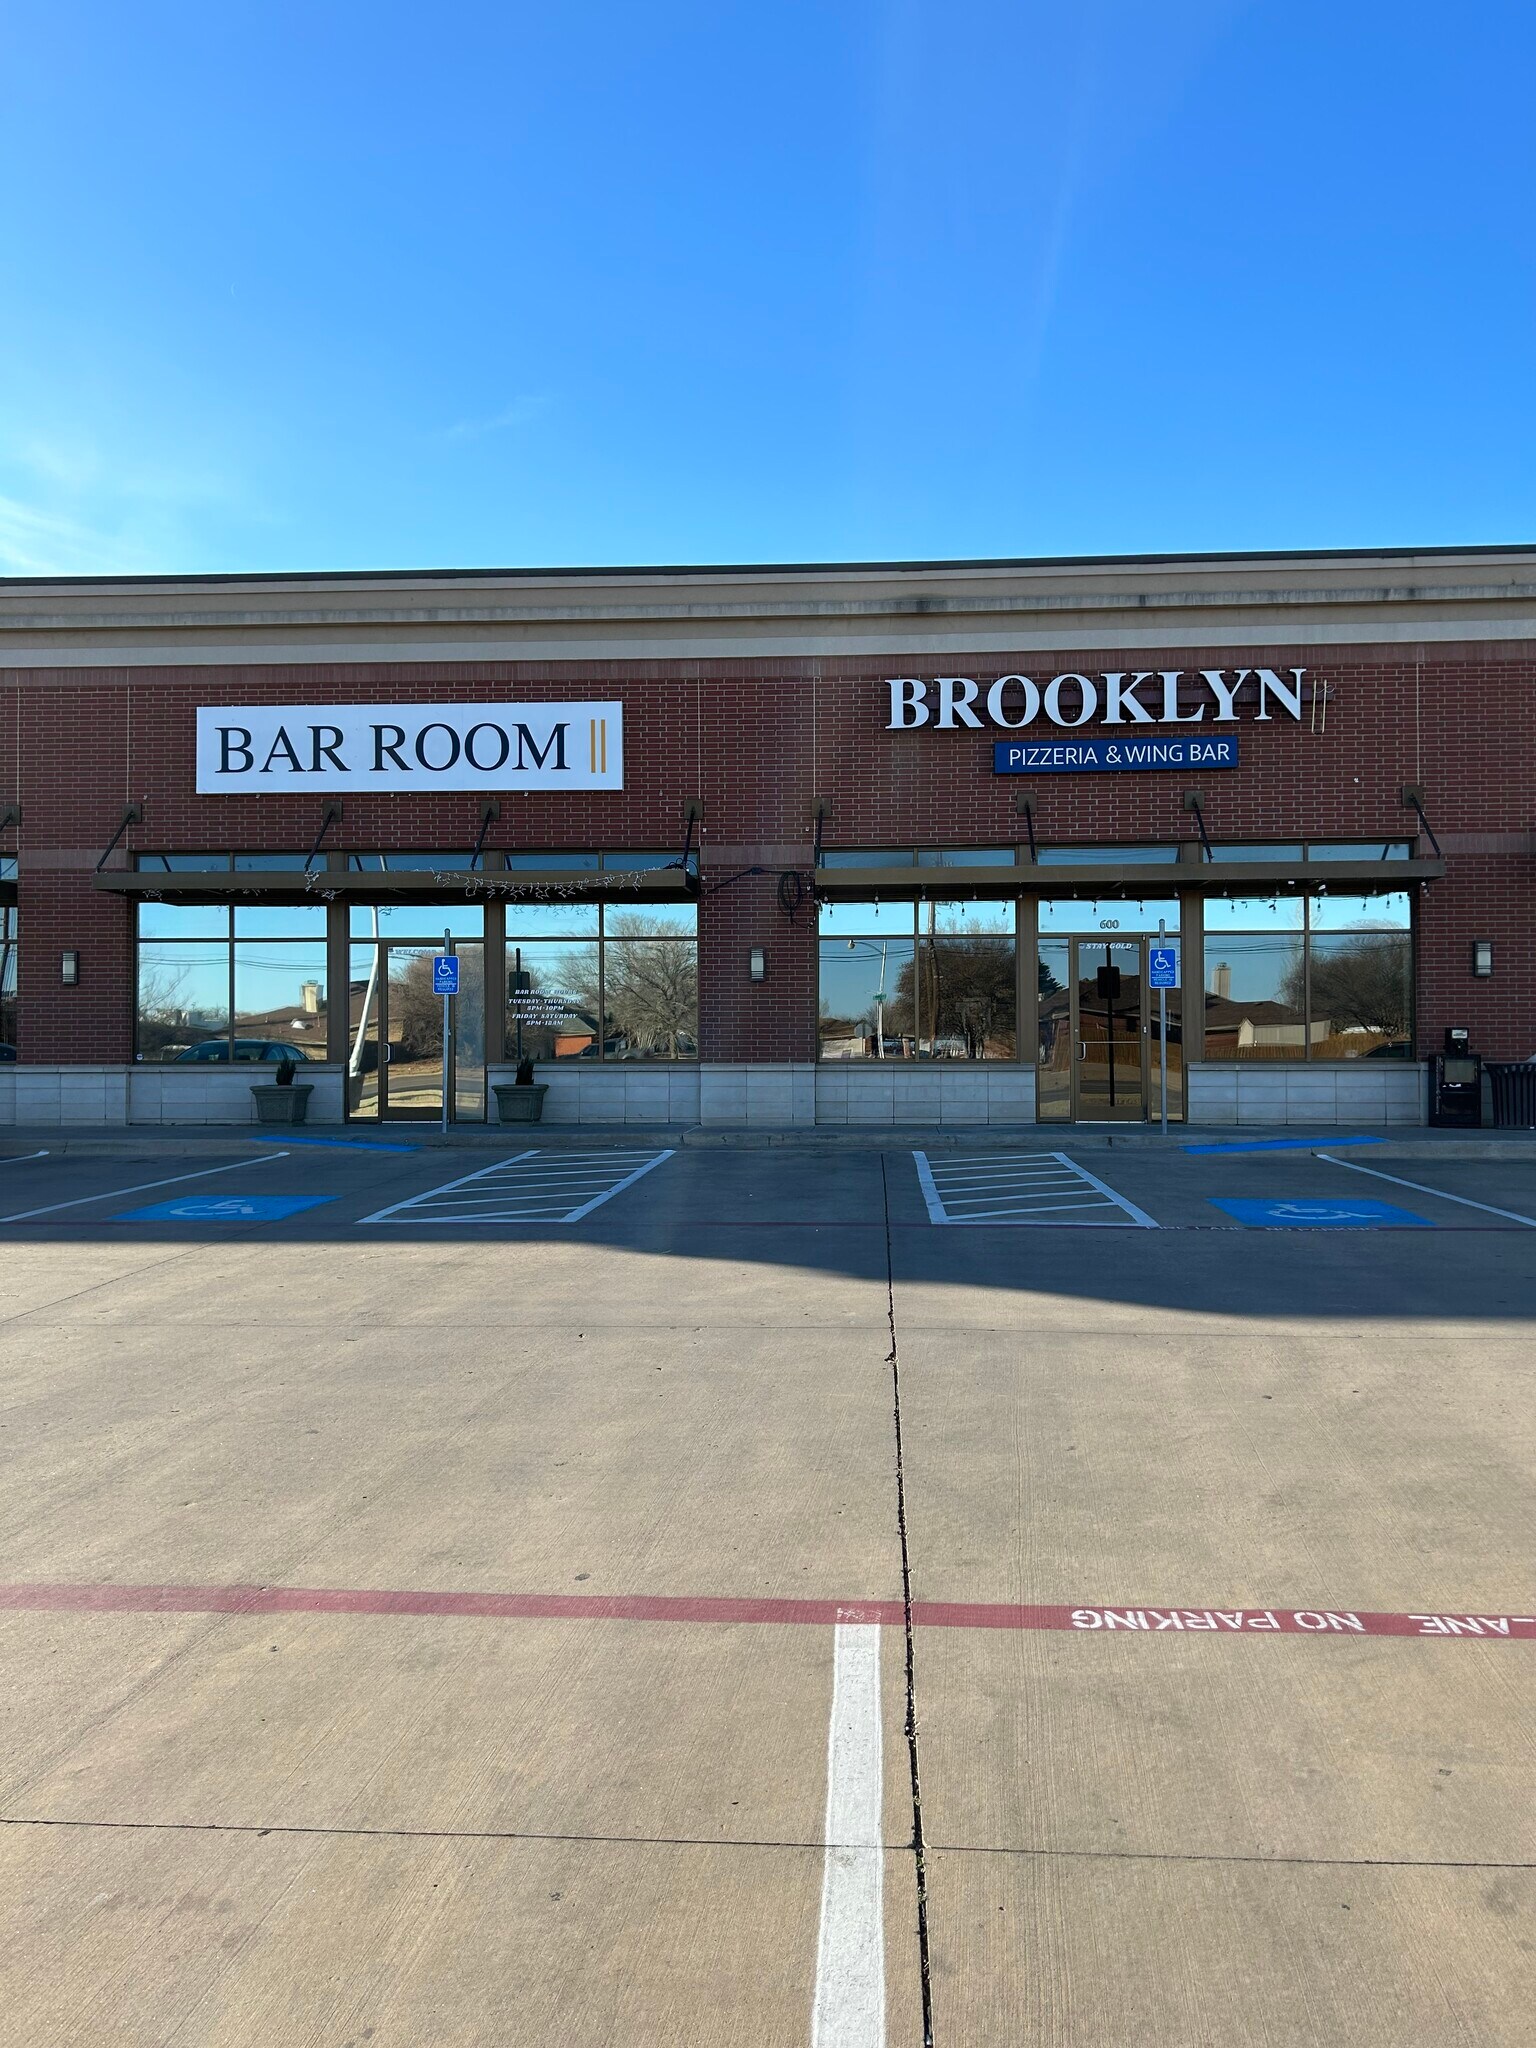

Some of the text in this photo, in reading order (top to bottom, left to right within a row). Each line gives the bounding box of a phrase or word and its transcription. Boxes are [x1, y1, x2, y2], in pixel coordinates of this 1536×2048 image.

[885, 668, 1307, 729] BROOKLYN
[214, 722, 572, 774] BAR ROOM
[1008, 747, 1098, 767] PIZZERIA
[1189, 743, 1231, 761] BAR
[1099, 919, 1120, 929] 600
[1085, 942, 1133, 950] STAY GOLD
[1071, 1609, 1281, 1630] PARKING
[1293, 1611, 1366, 1631] NO
